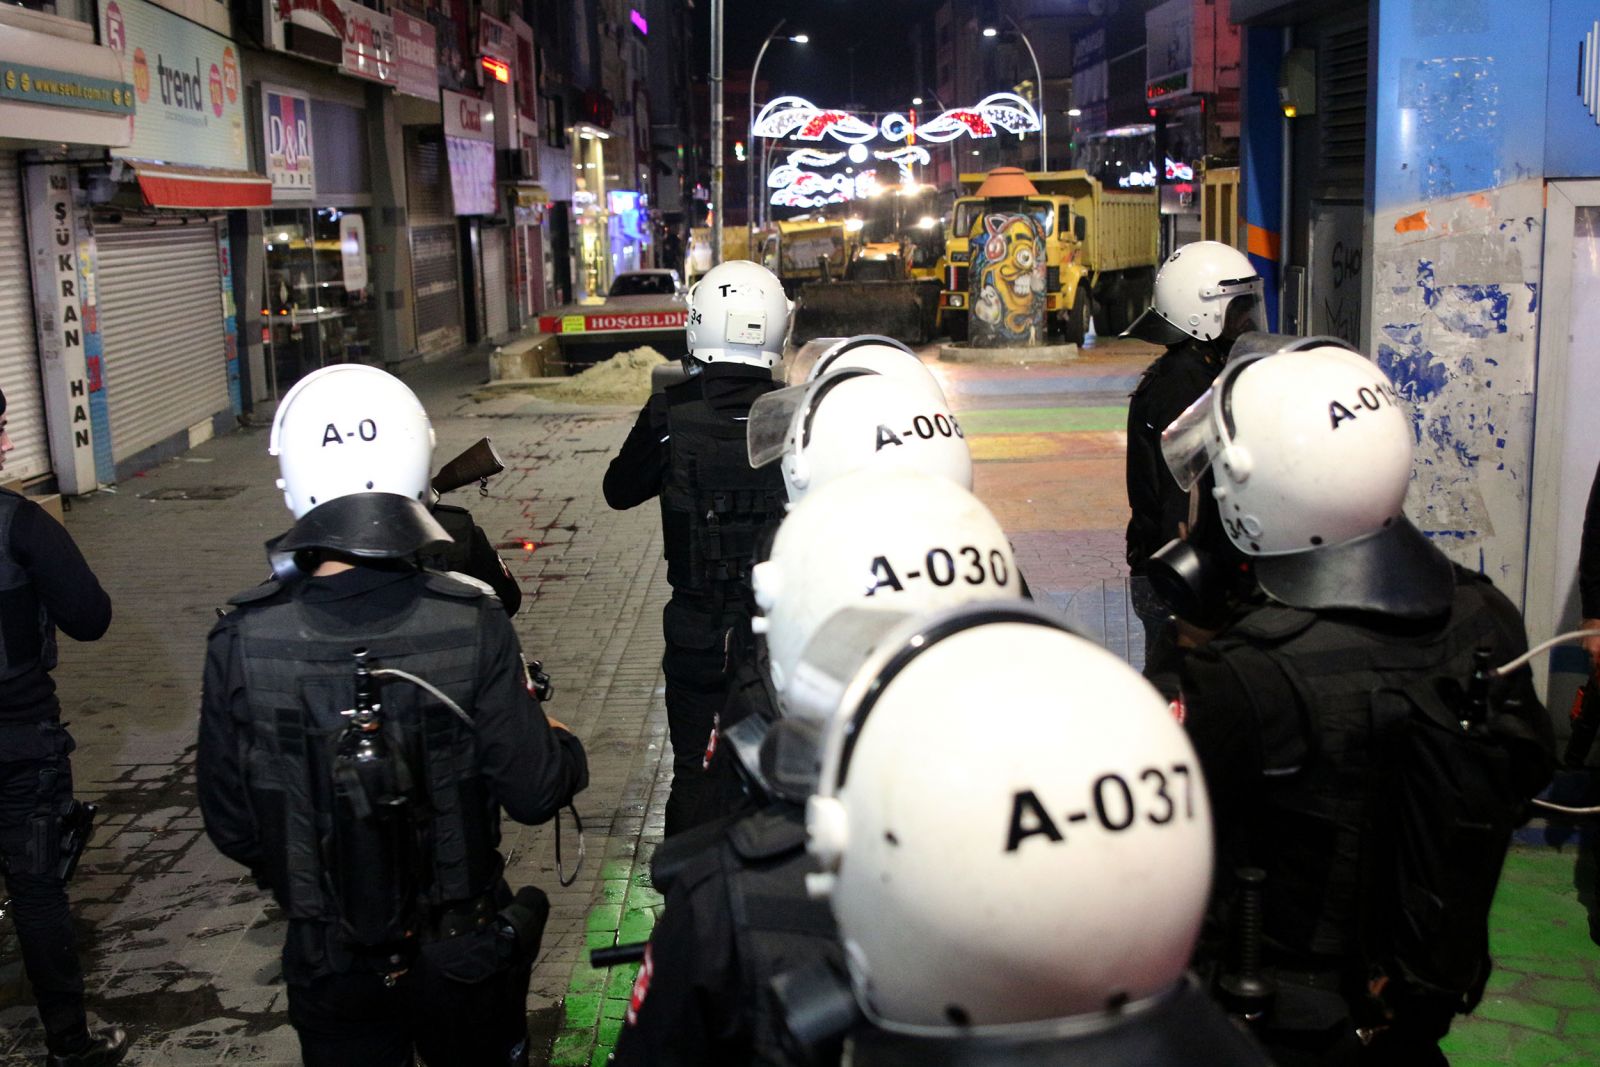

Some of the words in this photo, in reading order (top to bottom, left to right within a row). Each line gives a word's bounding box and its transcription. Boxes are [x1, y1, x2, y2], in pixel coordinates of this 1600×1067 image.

[157, 54, 203, 112] trend
[270, 115, 308, 166] D&R
[54, 203, 80, 348] ŞÜKRAN
[71, 380, 88, 447] HAN
[591, 311, 690, 329] HOŞGELDİ
[875, 412, 964, 452] A-008
[865, 546, 1009, 597] A-030
[1002, 763, 1196, 853] A-037
